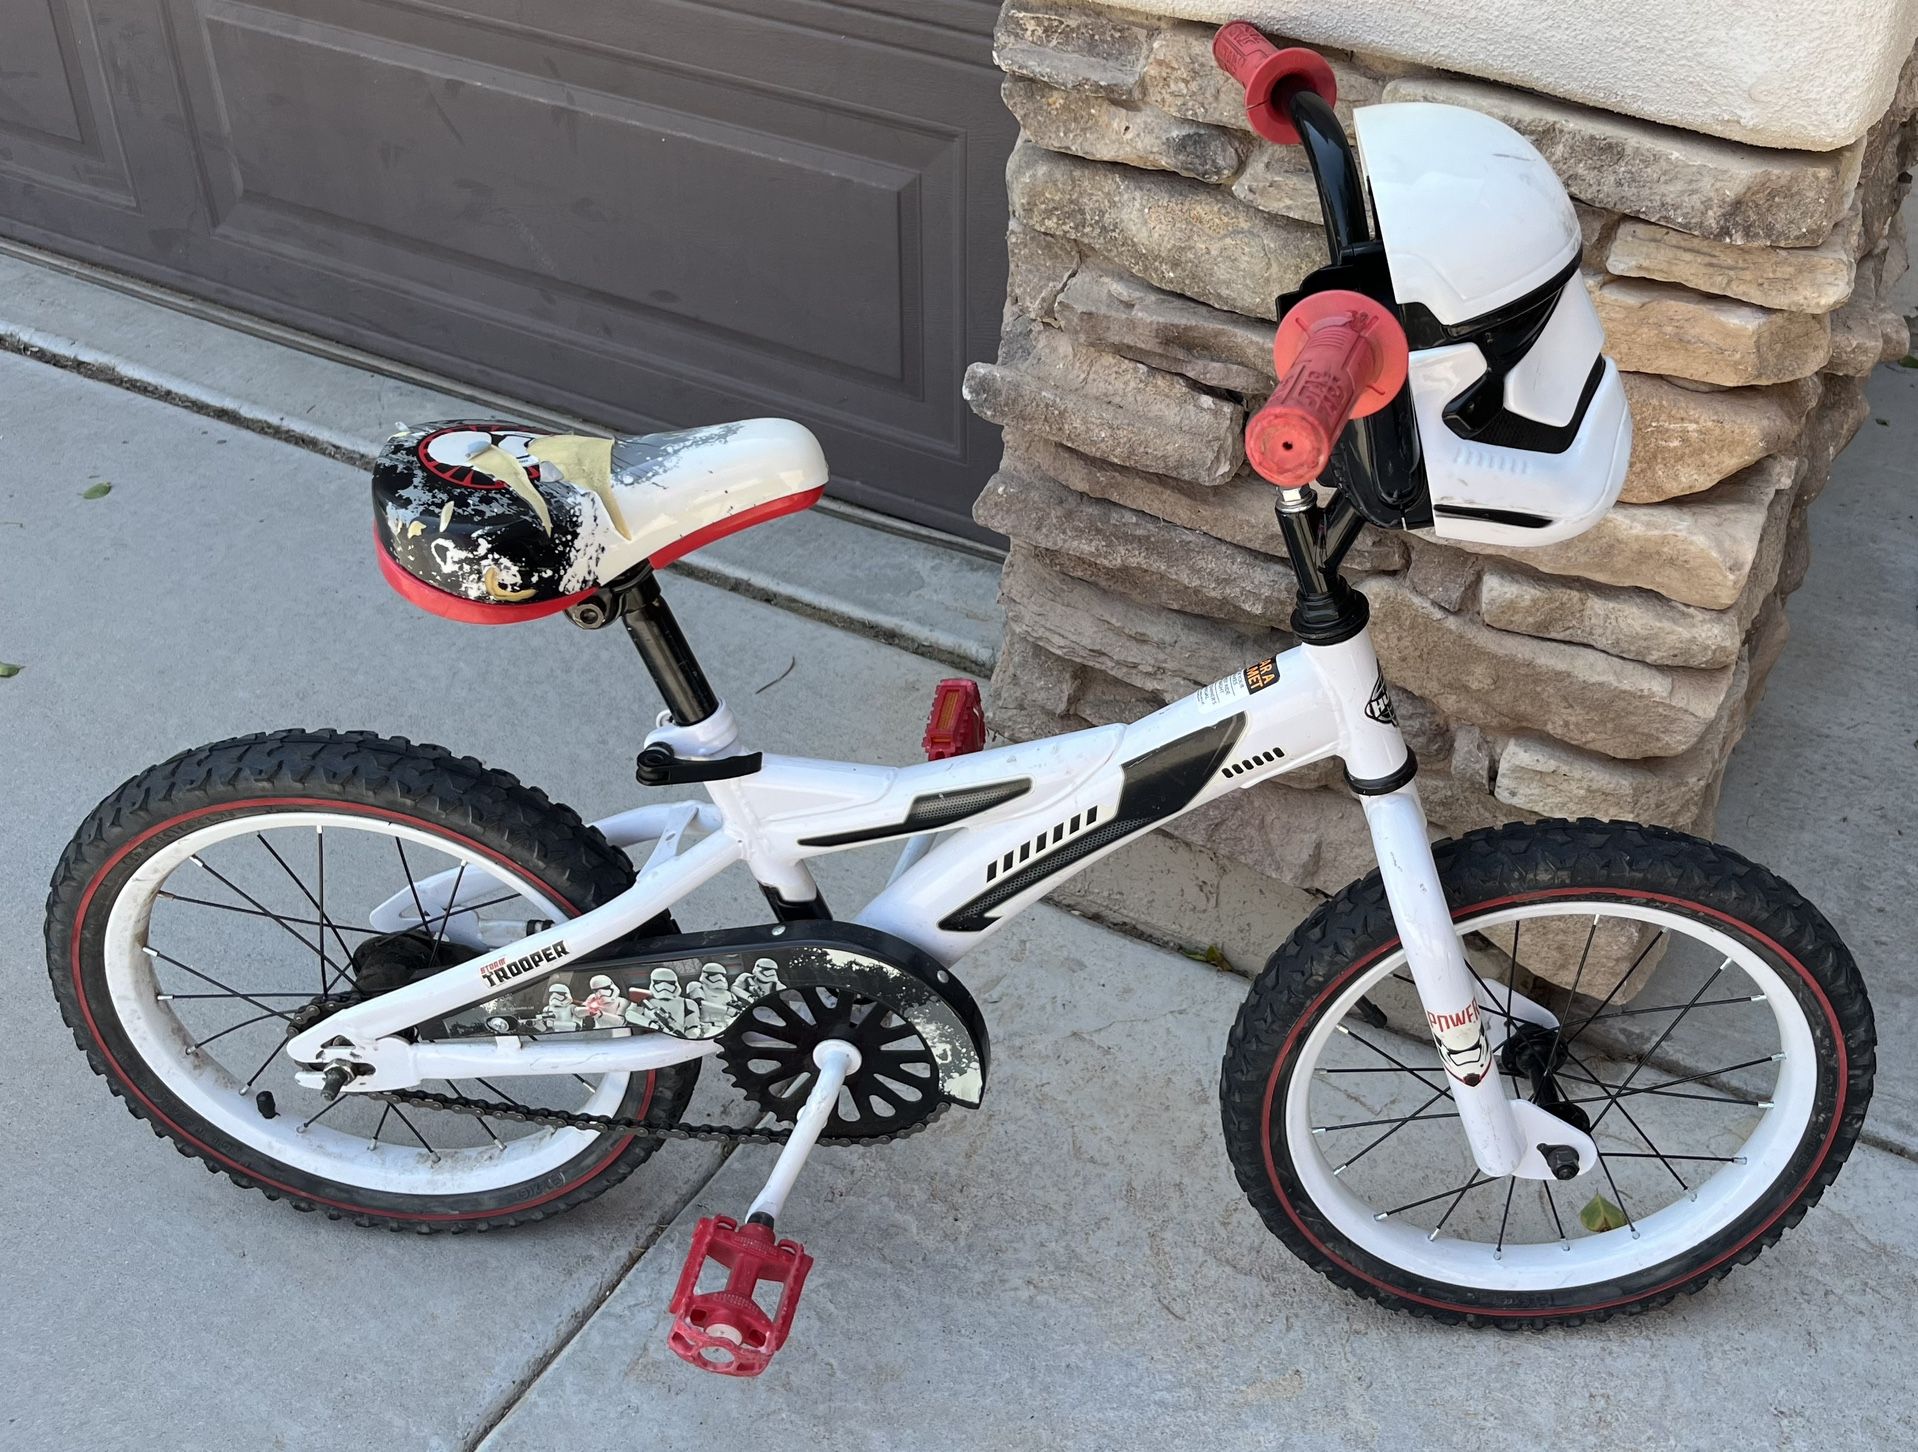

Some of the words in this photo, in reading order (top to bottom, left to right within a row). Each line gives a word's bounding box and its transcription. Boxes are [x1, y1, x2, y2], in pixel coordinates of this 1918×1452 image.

[1262, 674, 1276, 684] A
[480, 957, 506, 974] STORM
[482, 940, 570, 987] TROOPER
[1426, 996, 1480, 1033] POWER
